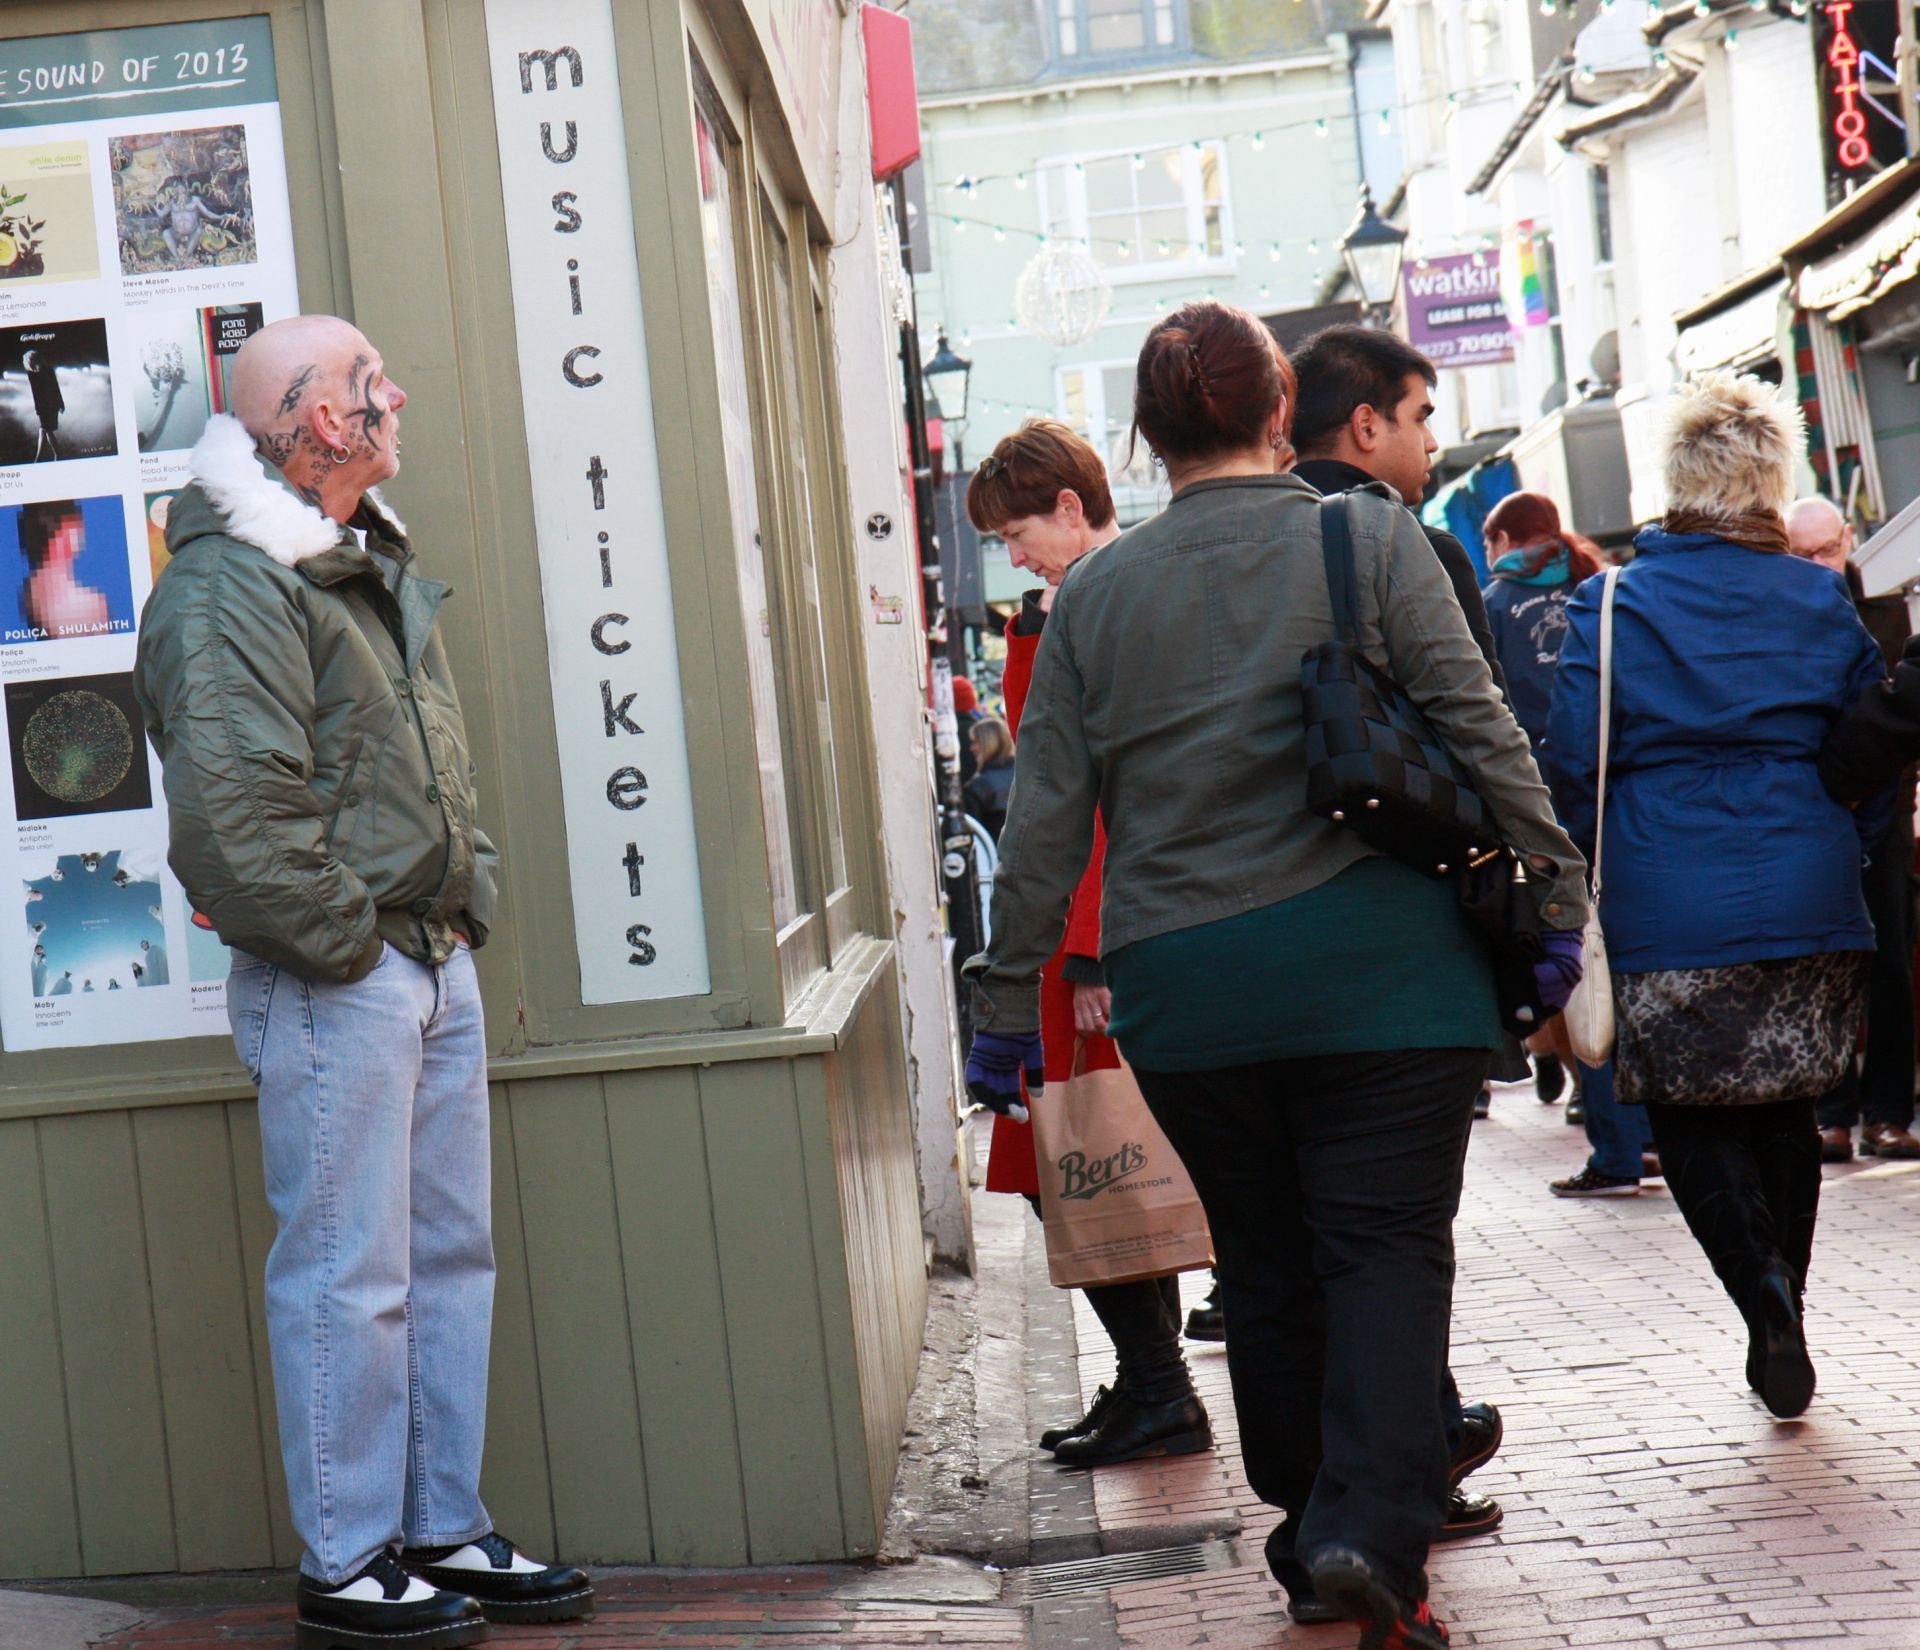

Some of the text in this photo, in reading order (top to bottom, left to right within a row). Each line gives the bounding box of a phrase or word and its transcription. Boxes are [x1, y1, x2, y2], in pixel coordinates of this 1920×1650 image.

[17, 61, 105, 95] SOUND
[122, 55, 160, 82] OF
[174, 43, 248, 79] 2013
[1825, 3, 1871, 167] TATTOO
[29, 154, 82, 165] white denim
[518, 45, 603, 388] music
[123, 277, 170, 288] Steve Mason
[123, 290, 153, 299] Monkey
[154, 286, 177, 295] Minds
[186, 284, 200, 292] The
[201, 282, 226, 290] Devil's
[227, 279, 245, 288] Time
[6, 300, 47, 310] Lemonade
[221, 318, 246, 329] POND
[20, 332, 55, 342] Goldfrapp
[222, 328, 247, 339] HOBO
[140, 457, 159, 465] Pond
[0, 471, 21, 479] frapp
[141, 466, 162, 475] Hobo
[4, 481, 13, 489] Of
[15, 480, 24, 488] Us
[141, 475, 168, 484] modular
[5, 619, 130, 641] POLIÇA SHULAMITH
[1, 649, 24, 657] Poliça
[1, 657, 38, 667] Shulamith
[2, 664, 60, 676] memphis industries
[586, 455, 658, 966] tickets
[18, 824, 48, 832] Midlake
[19, 833, 53, 844] Antiphon
[19, 844, 35, 852] bella
[191, 984, 222, 993] Moderat
[34, 1001, 55, 1009] Moby
[35, 1010, 72, 1019] Innocents
[36, 1019, 64, 1028] little idiot
[1058, 1142, 1148, 1199] Bert's
[1108, 1176, 1173, 1194] HOMESTORE
